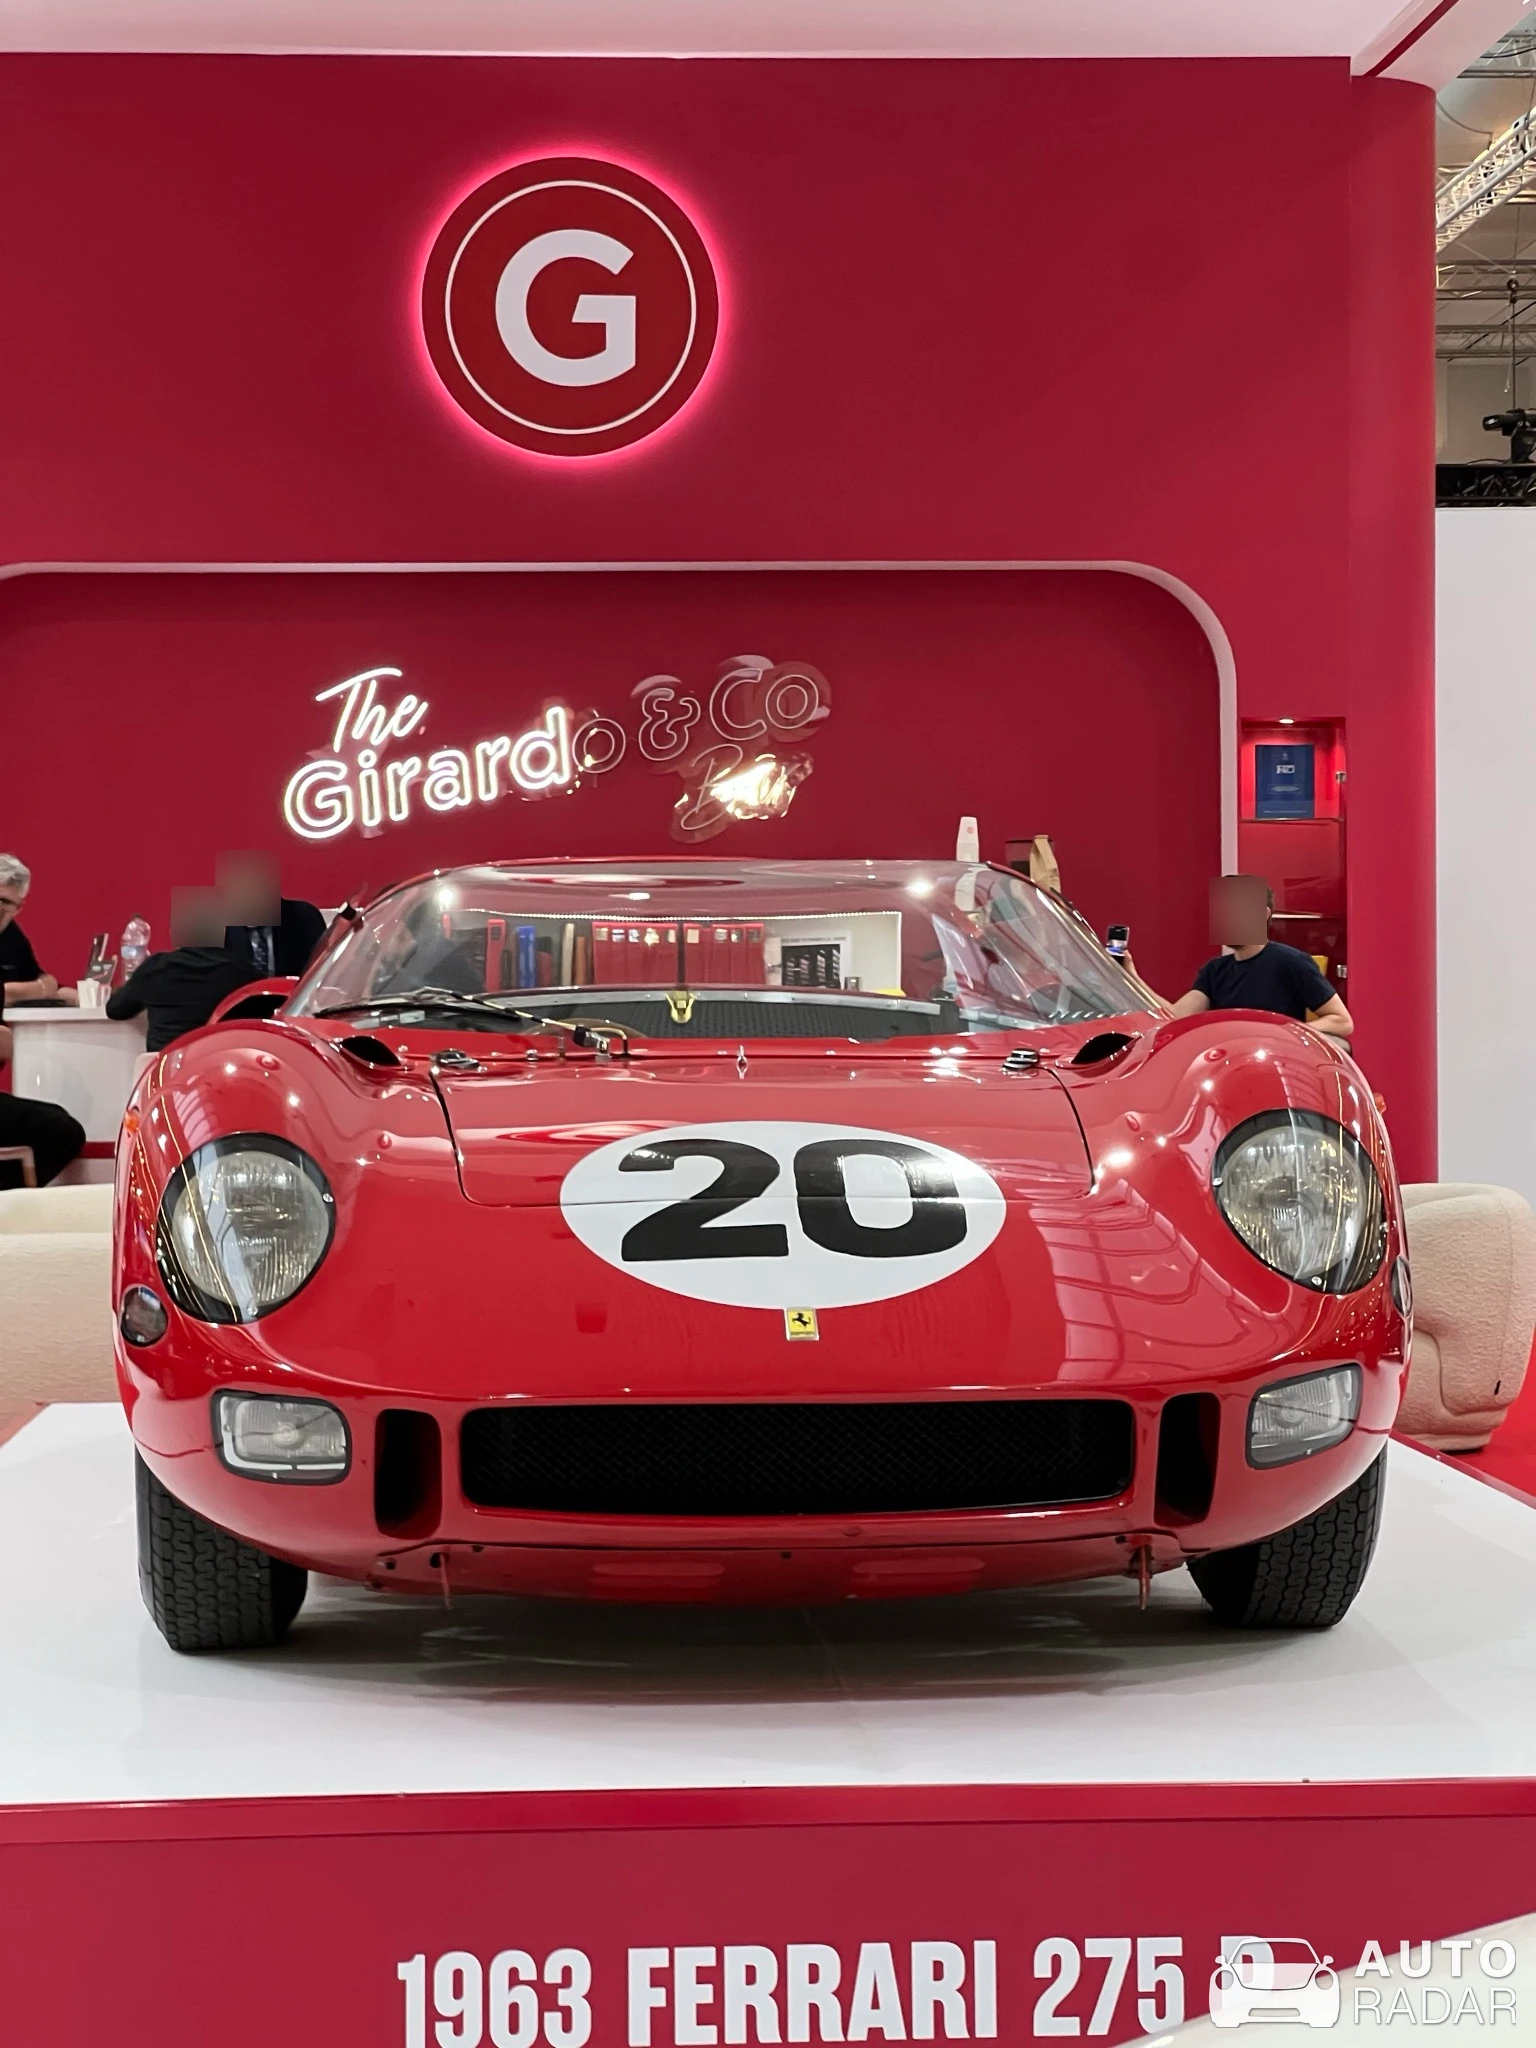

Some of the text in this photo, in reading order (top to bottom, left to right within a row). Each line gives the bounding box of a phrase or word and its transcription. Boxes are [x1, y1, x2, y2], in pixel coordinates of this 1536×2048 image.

[495, 228, 636, 387] G
[284, 706, 626, 839] Girardo
[638, 687, 701, 761] &
[315, 667, 429, 753] The
[618, 1138, 968, 1262] 20
[397, 1948, 592, 2048] 1963
[627, 1939, 998, 2047] FERRARI
[1033, 1936, 1185, 2037] 275
